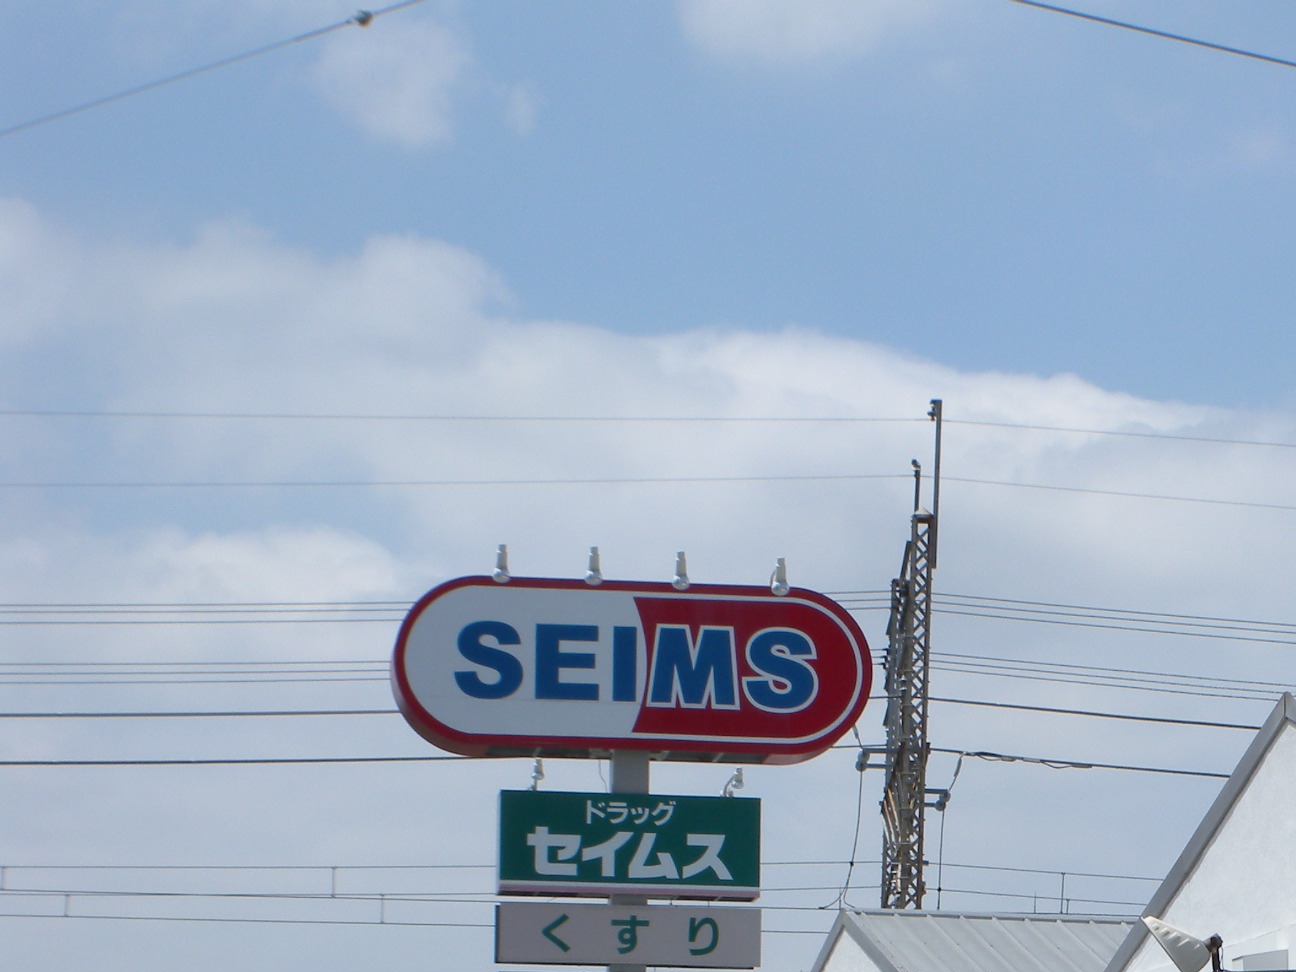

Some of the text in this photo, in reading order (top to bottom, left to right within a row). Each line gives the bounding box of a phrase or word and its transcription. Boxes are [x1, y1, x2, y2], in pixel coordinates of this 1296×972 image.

[454, 619, 820, 714] SEIMS
[585, 800, 676, 826] ドラッグ
[526, 826, 734, 881] セイムス
[541, 913, 720, 956] くすり
